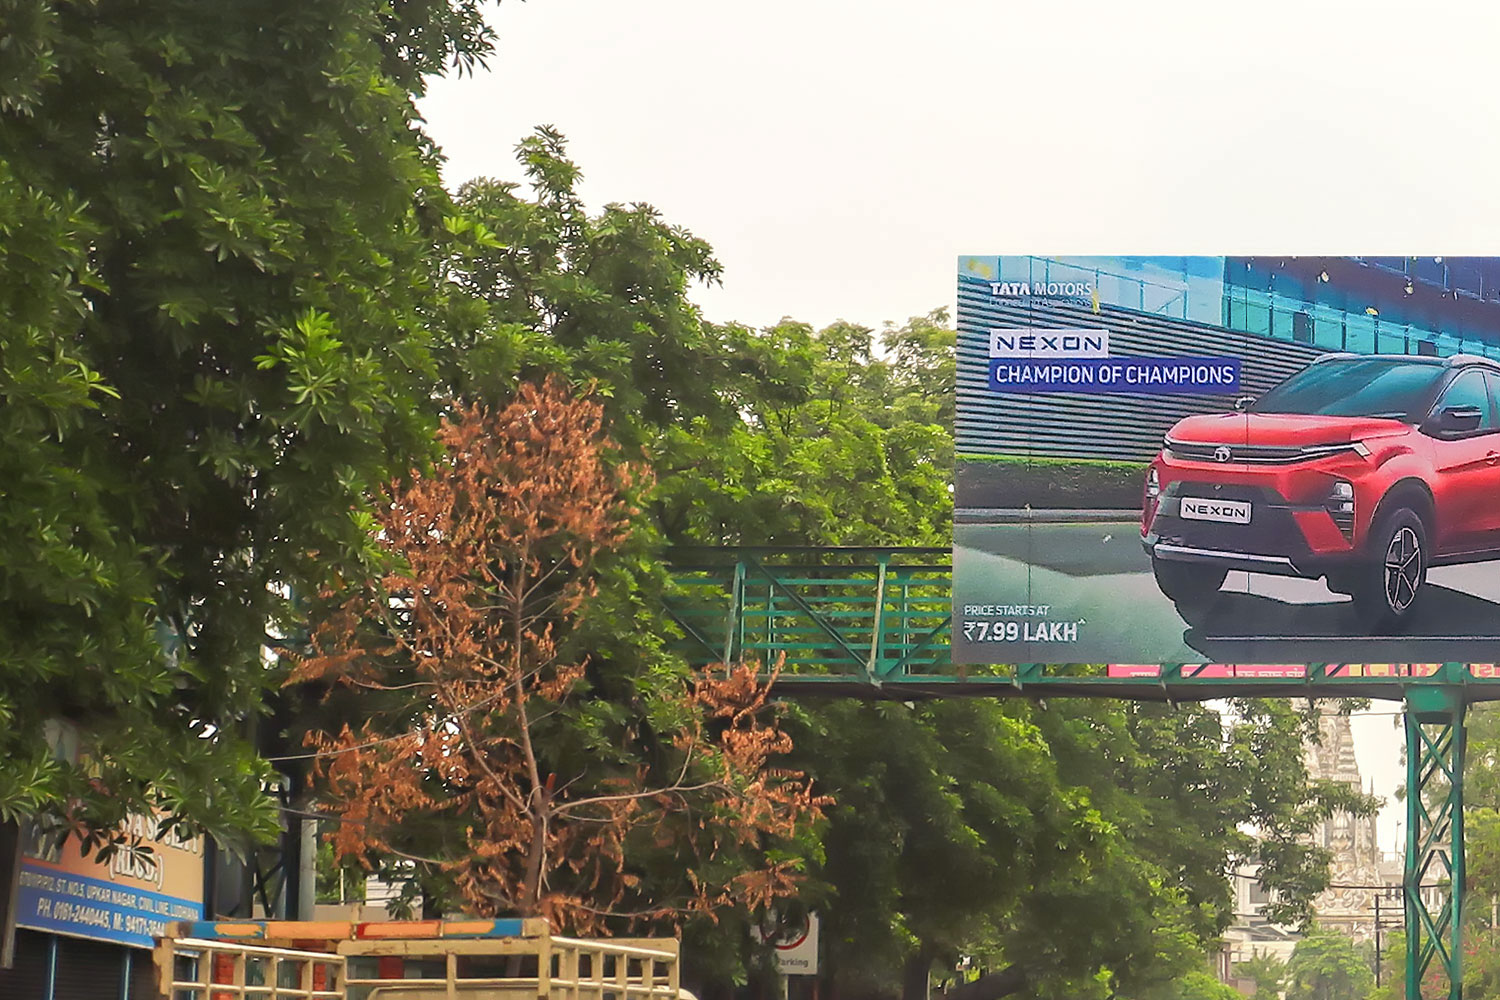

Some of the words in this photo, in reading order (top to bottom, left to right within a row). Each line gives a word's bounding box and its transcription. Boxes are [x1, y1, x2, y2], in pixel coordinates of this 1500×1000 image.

[990, 282, 1030, 296] TATA
[1034, 282, 1092, 296] MOTORS
[997, 336, 1102, 350] NEXON
[997, 365, 1094, 384] CHAMPION
[1099, 366, 1122, 384] OF
[1126, 366, 1234, 384] CHAMPIONS
[1185, 503, 1246, 518] NEXON
[964, 605, 995, 616] PRICE
[996, 605, 1034, 616] STARTS
[1035, 605, 1050, 616] AT
[963, 621, 1019, 642] ₹7.99
[87, 886, 111, 903] UPKAR
